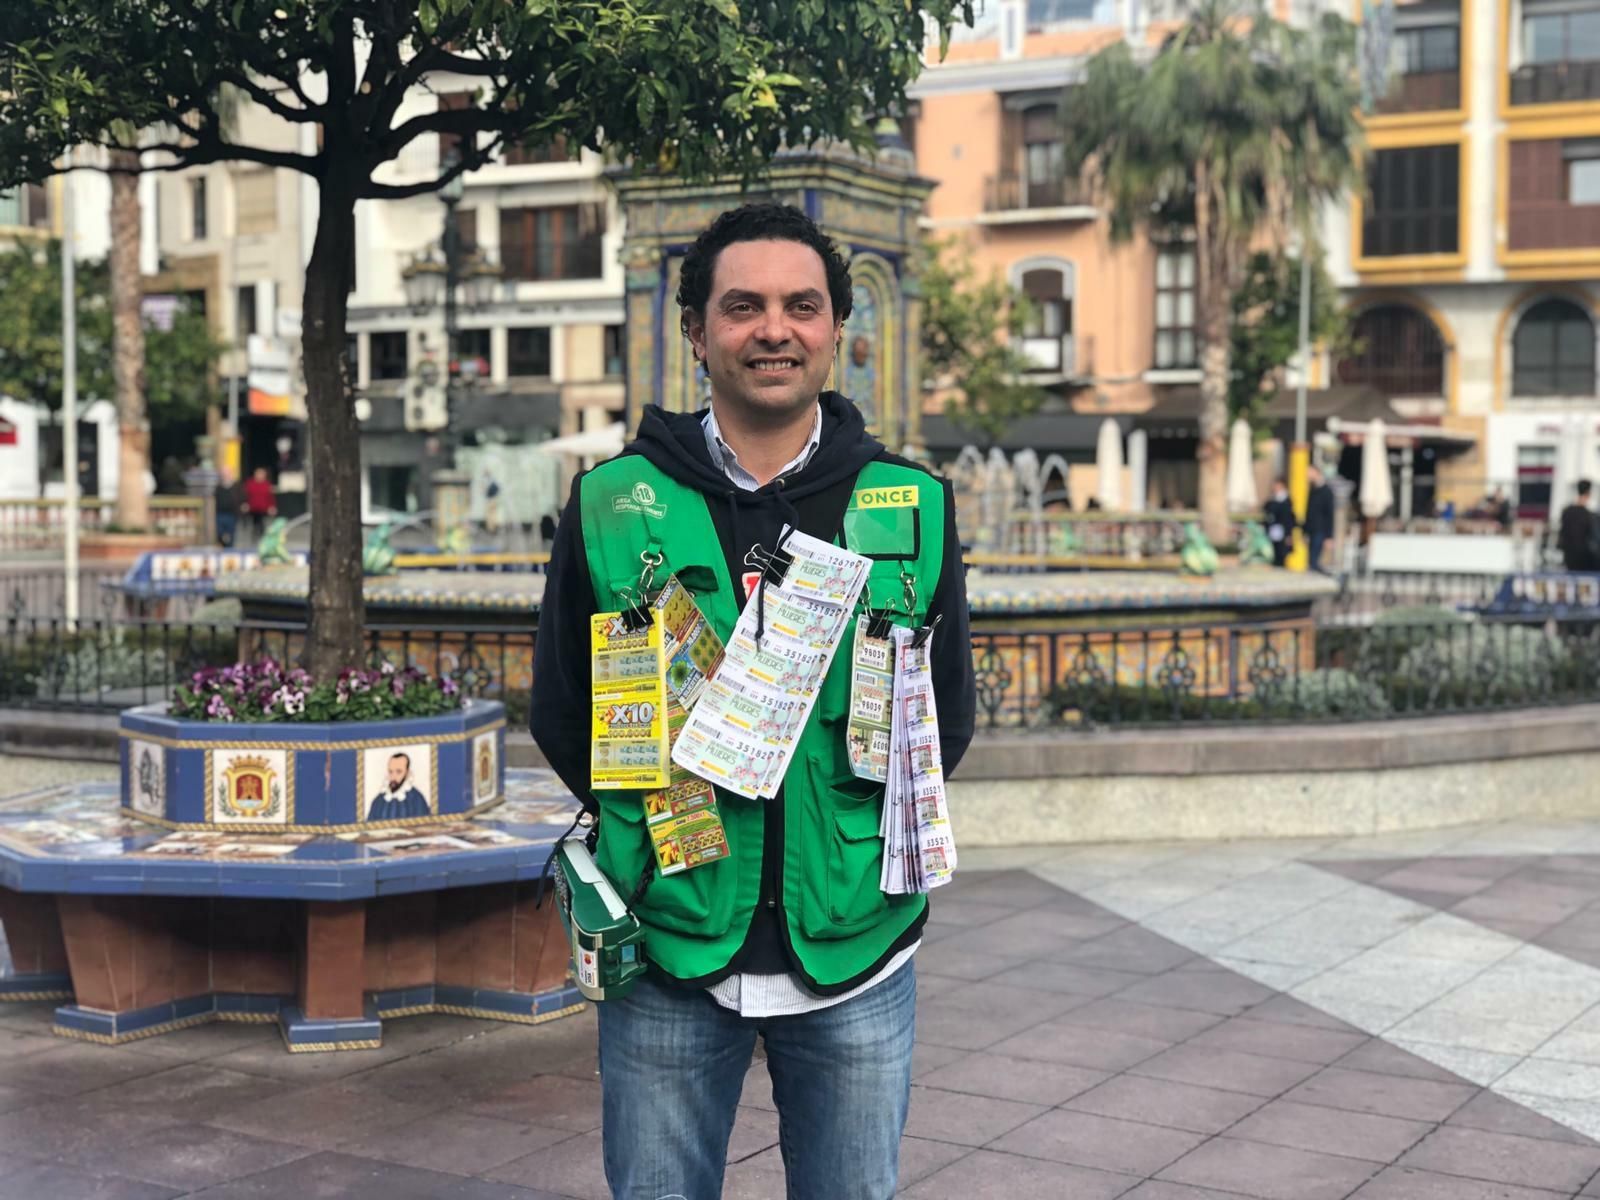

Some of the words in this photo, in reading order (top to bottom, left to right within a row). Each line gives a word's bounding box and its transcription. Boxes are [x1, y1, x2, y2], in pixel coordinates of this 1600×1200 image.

[861, 490, 913, 504] ONCE
[828, 556, 855, 569] 12679
[777, 607, 806, 624] MUJERES
[806, 602, 835, 617] 35182
[784, 649, 812, 663] 35182
[863, 647, 886, 659] 98039
[760, 695, 787, 710] 35182
[861, 700, 882, 712] 98039
[611, 702, 654, 724] X10
[705, 744, 736, 765] MUJERES
[736, 742, 767, 760] 35182
